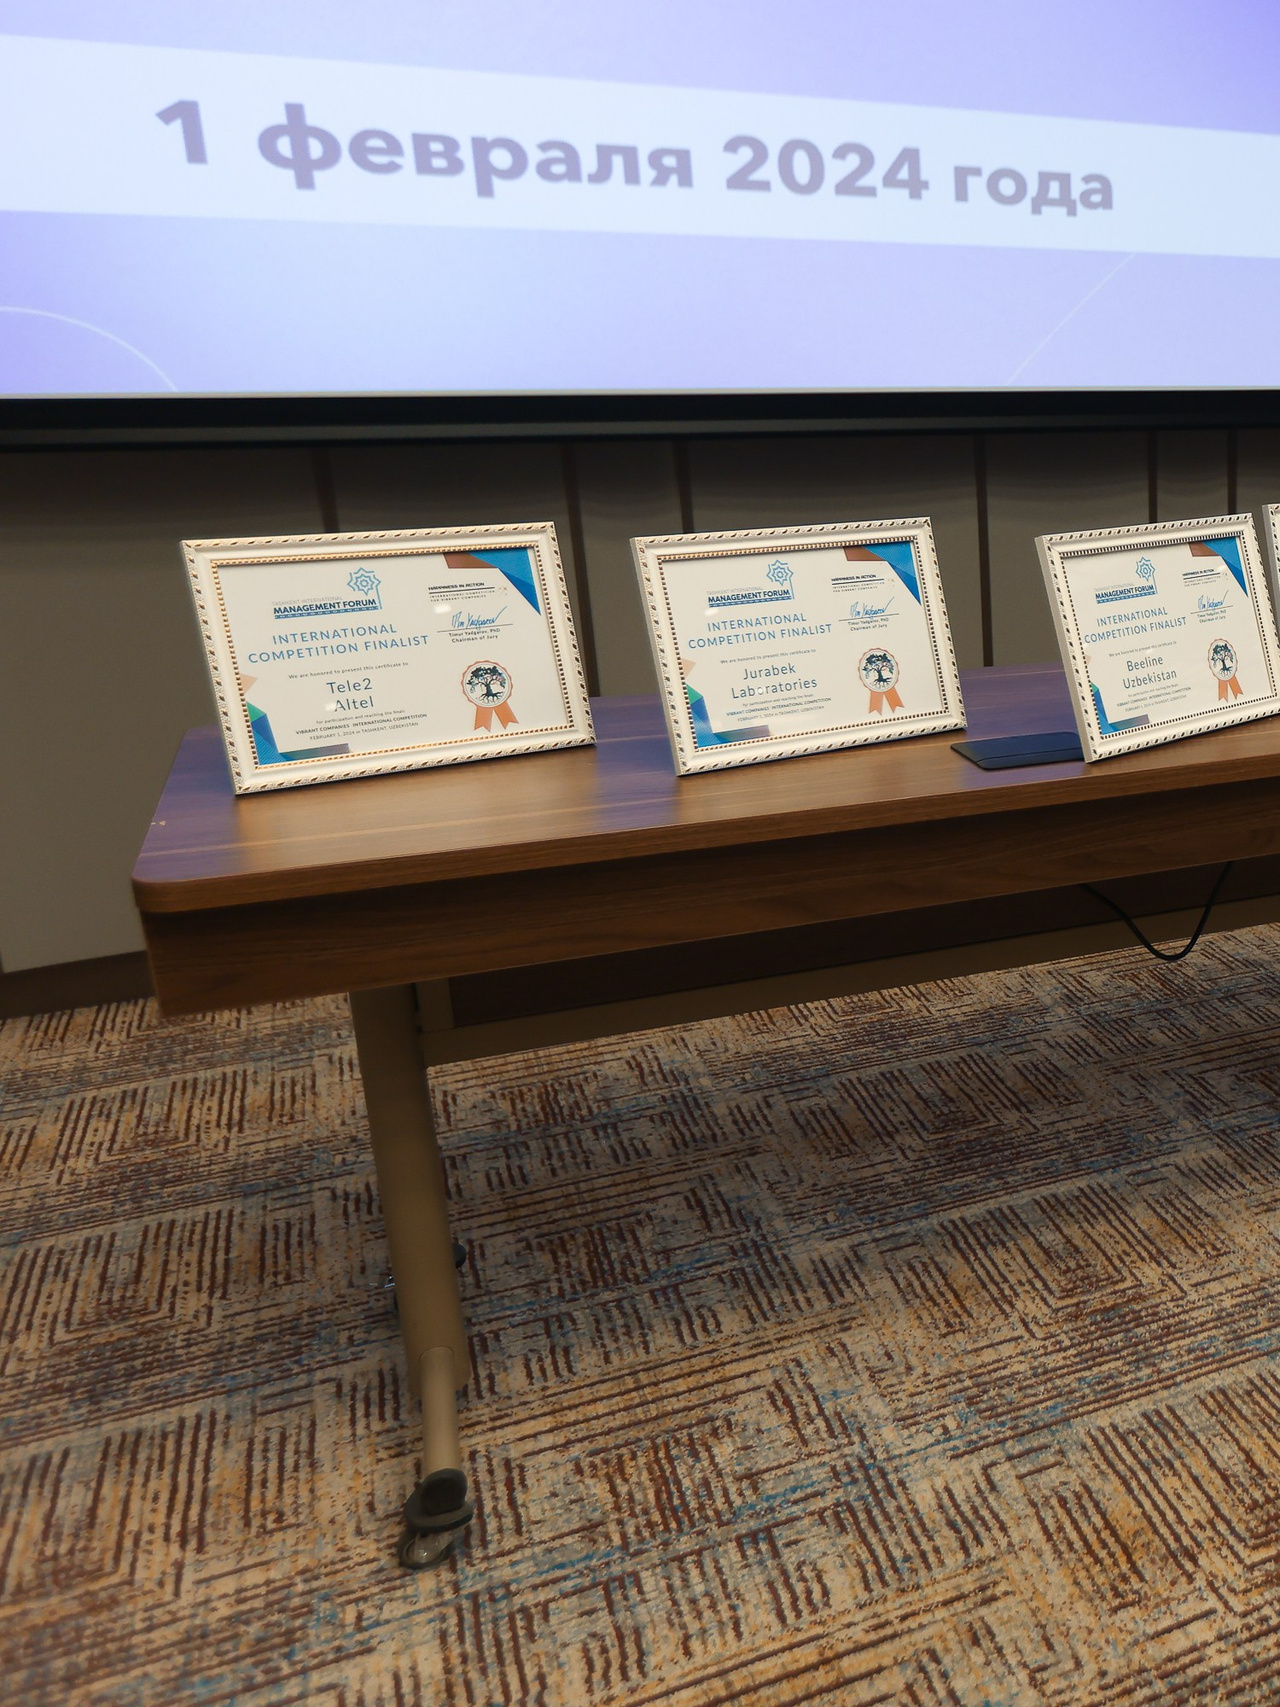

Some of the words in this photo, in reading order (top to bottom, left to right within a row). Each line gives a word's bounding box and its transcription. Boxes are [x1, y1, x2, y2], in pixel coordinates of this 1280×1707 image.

[156, 99, 208, 165] 1
[257, 101, 694, 199] февраля
[722, 134, 929, 201] 2024
[953, 165, 1114, 218] года
[708, 592, 762, 603] MANAGEMENT
[763, 589, 790, 598] FORUM
[1095, 588, 1134, 600] MANAGEMENT
[1135, 585, 1154, 593] FORUM
[273, 602, 342, 614] MANAGEMENT
[343, 599, 377, 608] FORUM
[707, 613, 807, 632] INTERNATIONAL
[1097, 607, 1168, 627] INTERNATIONAL
[272, 624, 397, 645] INTERNATIONAL
[688, 630, 776, 649] COMPETITION
[780, 624, 833, 638] FINALIST
[1084, 624, 1147, 644] COMPETITION
[1150, 617, 1187, 631] FINALIST
[248, 643, 359, 664] COMPETITION
[364, 635, 430, 651] FINALIST
[742, 662, 796, 680] Jurabek
[1126, 654, 1164, 672] Beeline
[326, 677, 373, 694] Tele2
[731, 677, 818, 699] Laboratories
[1123, 668, 1177, 689] Uzbekistan
[332, 696, 374, 712] Altel
